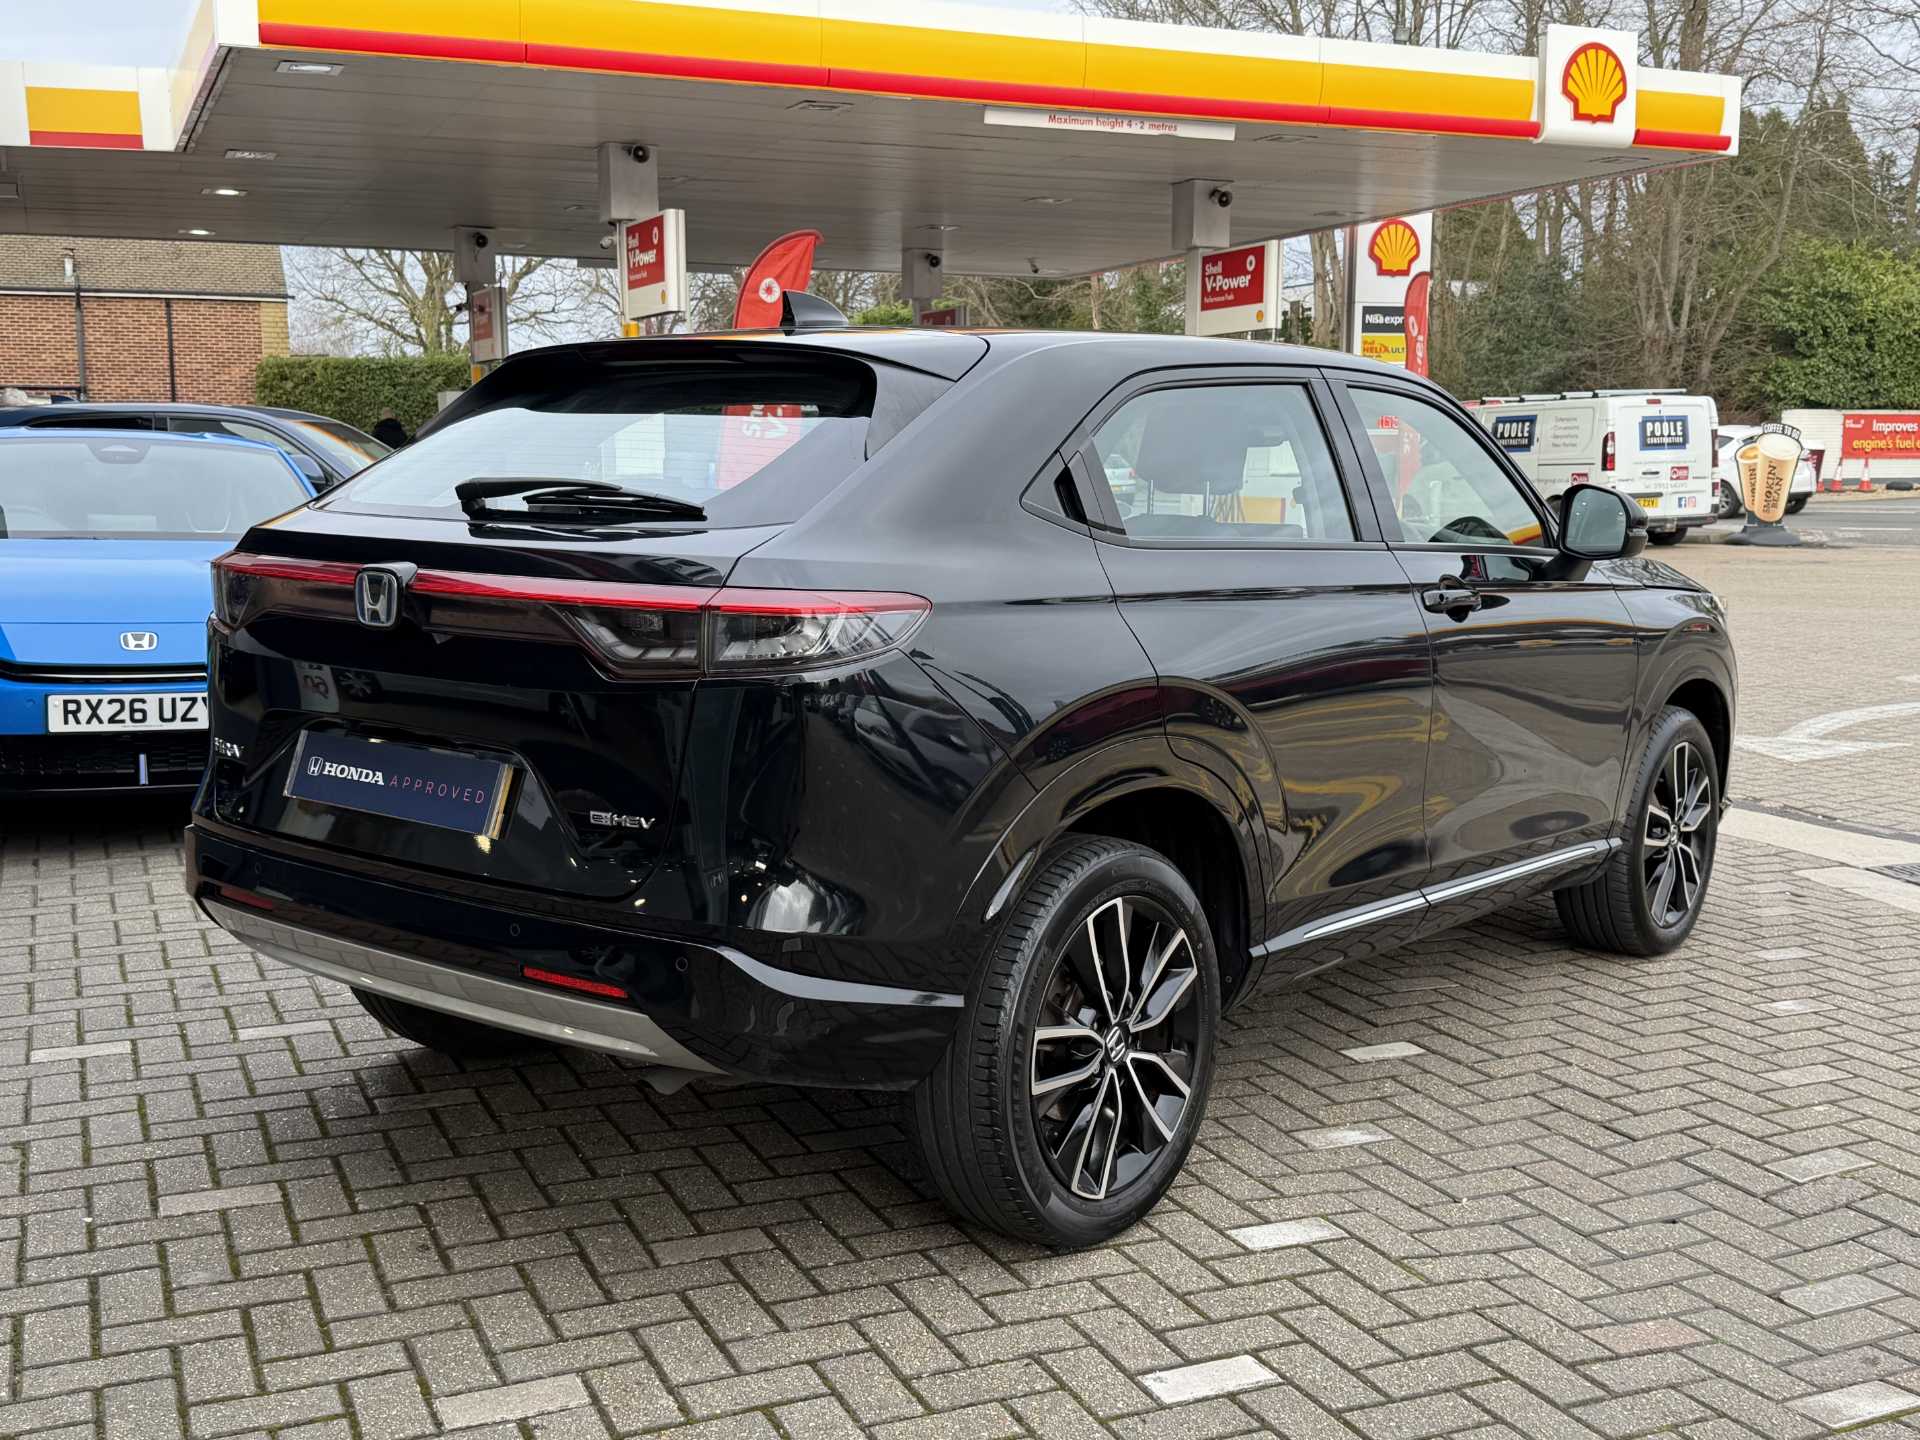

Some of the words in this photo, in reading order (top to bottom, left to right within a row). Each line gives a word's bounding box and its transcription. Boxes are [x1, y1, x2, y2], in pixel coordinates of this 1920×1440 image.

[1048, 114, 1093, 125] Maximum
[1096, 116, 1124, 129] height
[1148, 122, 1178, 132] metres
[1205, 260, 1222, 276] Shell
[1205, 274, 1251, 292] V-Power
[1365, 314, 1384, 324] Nisa
[1497, 422, 1530, 438] POOLE
[1646, 421, 1683, 436] POOLE
[1764, 423, 1783, 434] COFFEE
[1784, 426, 1792, 435] TO
[1872, 419, 1918, 435] Improves
[1647, 436, 1683, 444] CONSTRUCTION
[1853, 436, 1893, 452] engine's
[1896, 434, 1915, 449] fuel
[1772, 476, 1784, 510] BEAN
[63, 698, 148, 726] RX26
[322, 762, 385, 786] HONDA
[389, 775, 485, 804] APPROVED
